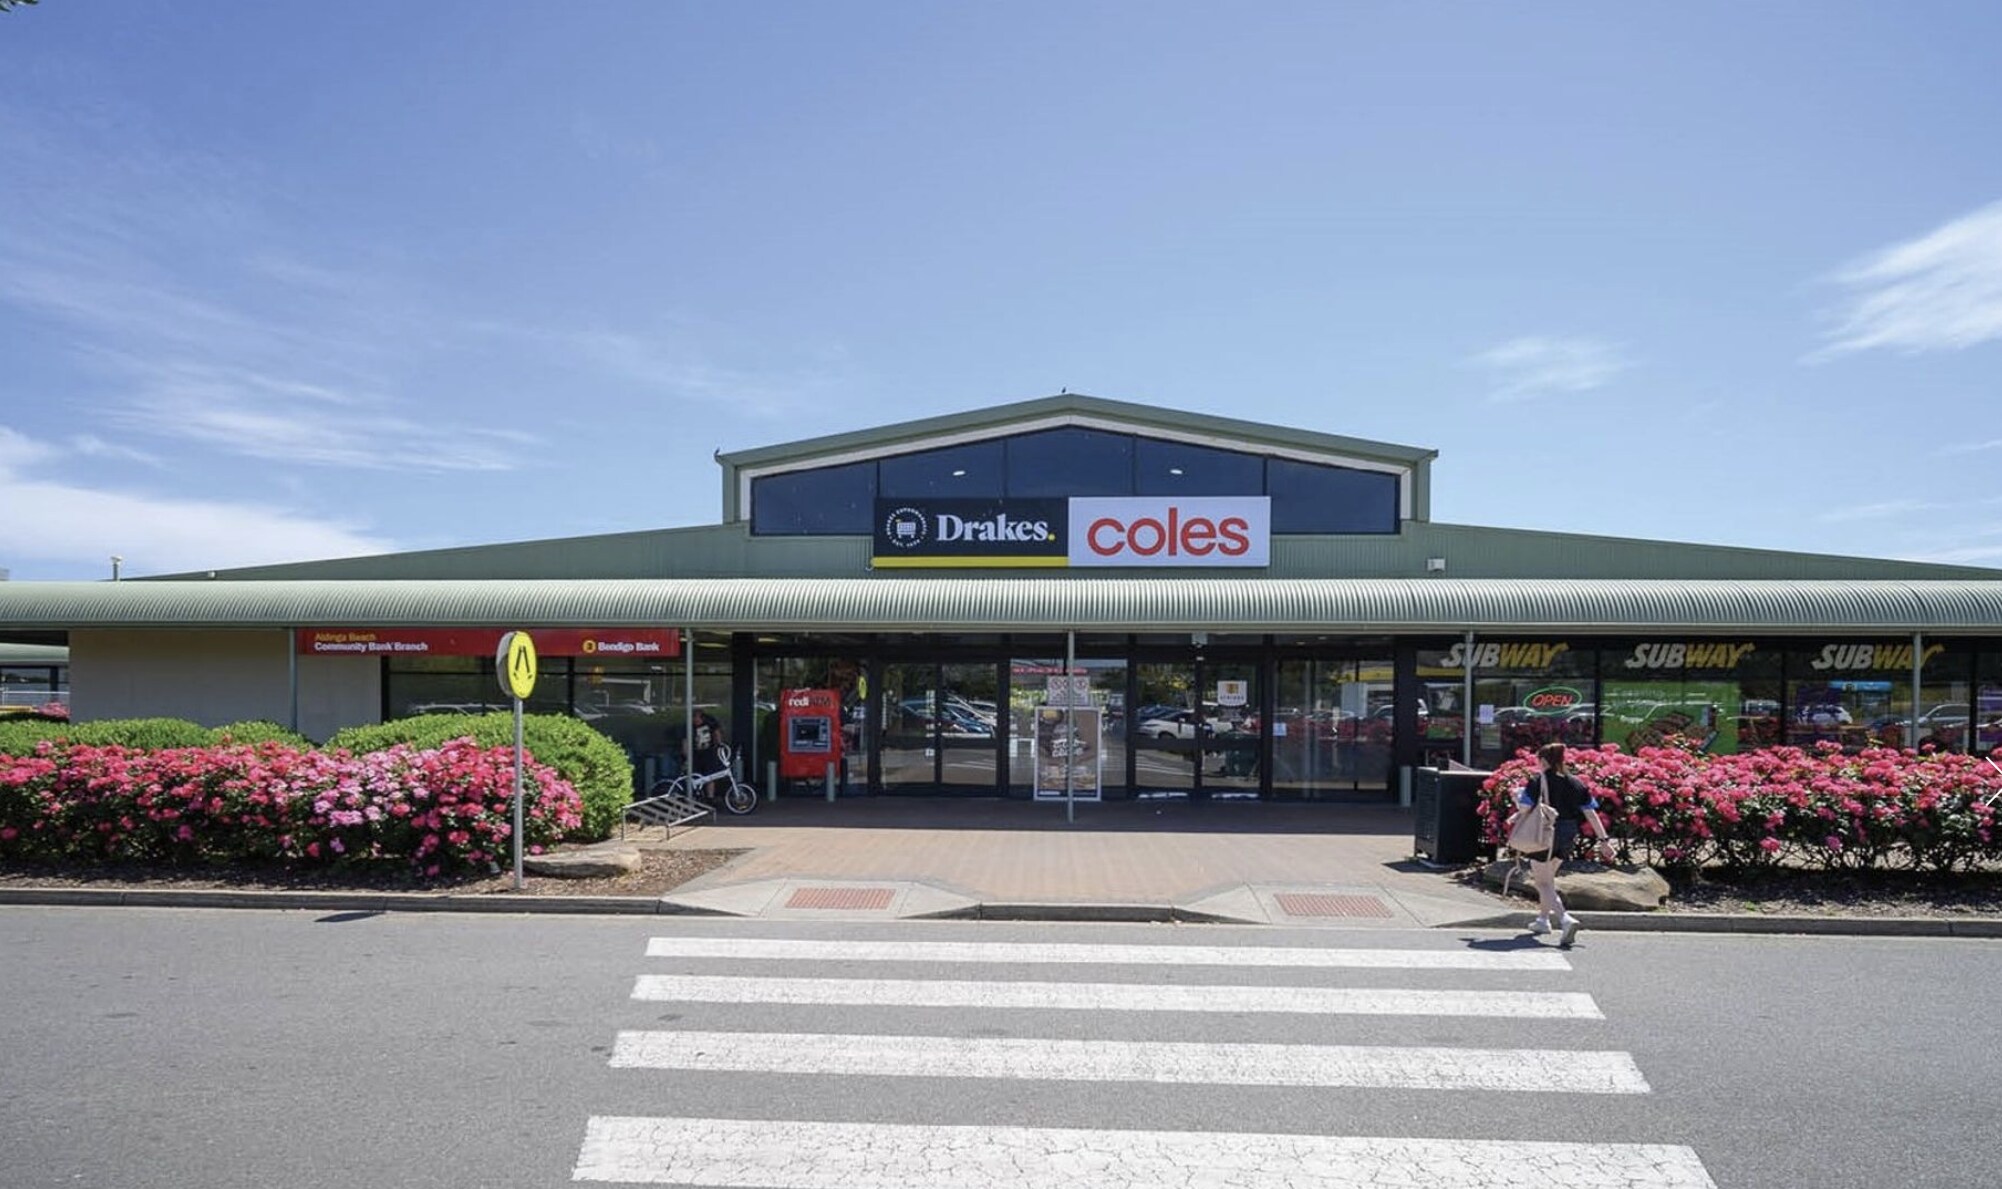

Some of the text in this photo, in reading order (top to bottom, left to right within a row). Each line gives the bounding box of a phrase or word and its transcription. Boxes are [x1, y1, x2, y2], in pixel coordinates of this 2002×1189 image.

[937, 513, 1055, 542] Drakes.
[1087, 507, 1250, 556] coles
[348, 632, 377, 641] Beach
[314, 642, 428, 652] Community Bank Branch
[598, 642, 659, 653] Bendigo Bank
[1440, 642, 1569, 668] SUBWAY
[1624, 642, 1756, 668] SUBWAY
[1531, 693, 1573, 707] OPEN
